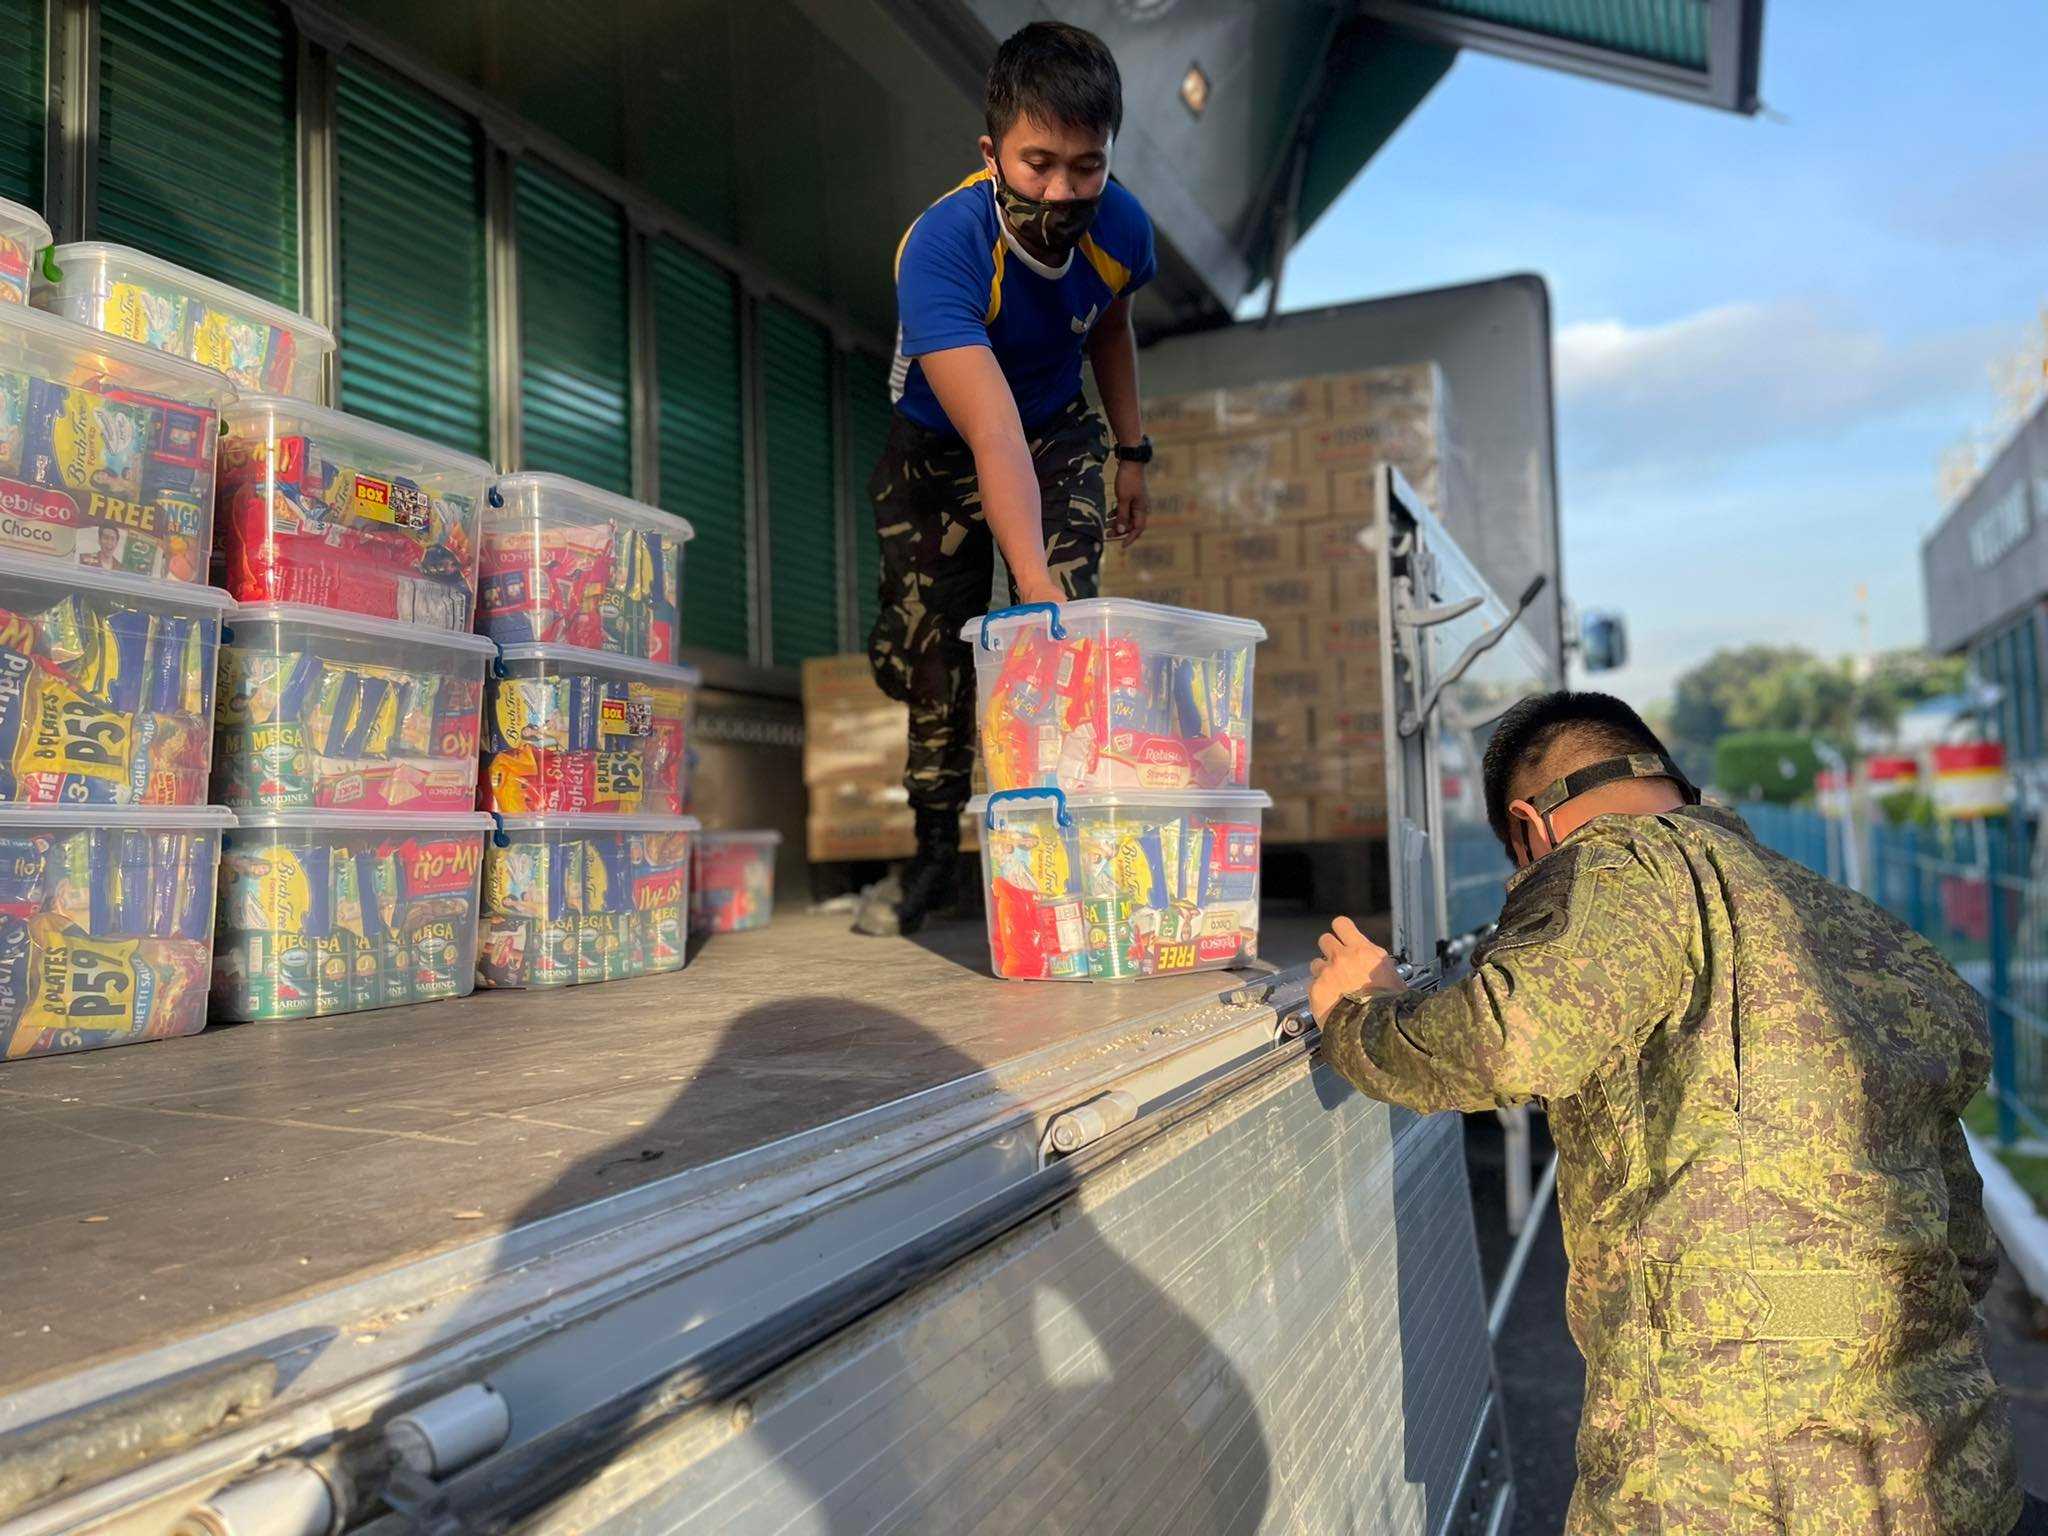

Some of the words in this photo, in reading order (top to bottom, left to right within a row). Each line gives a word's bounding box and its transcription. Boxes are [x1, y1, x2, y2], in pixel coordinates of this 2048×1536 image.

[71, 404, 87, 435] Tree
[66, 438, 87, 485] Birch
[0, 490, 71, 522] ebisco
[357, 484, 385, 504] BOX
[88, 492, 155, 532] FREE
[2, 518, 52, 542] Choco
[37, 692, 60, 744] PLATES
[505, 710, 520, 742] Birch
[603, 707, 623, 720] BOX
[252, 729, 304, 751] MEGA
[34, 749, 57, 760] 8
[260, 792, 308, 805] SARDINES
[276, 861, 297, 899] Birch
[276, 900, 295, 929] Tree
[412, 923, 455, 943] MEGA
[1158, 944, 1197, 970] FREE
[45, 947, 68, 1002] PLATES
[68, 950, 129, 1017] P59
[415, 980, 457, 993] SARDINES
[43, 1003, 67, 1017] 8
